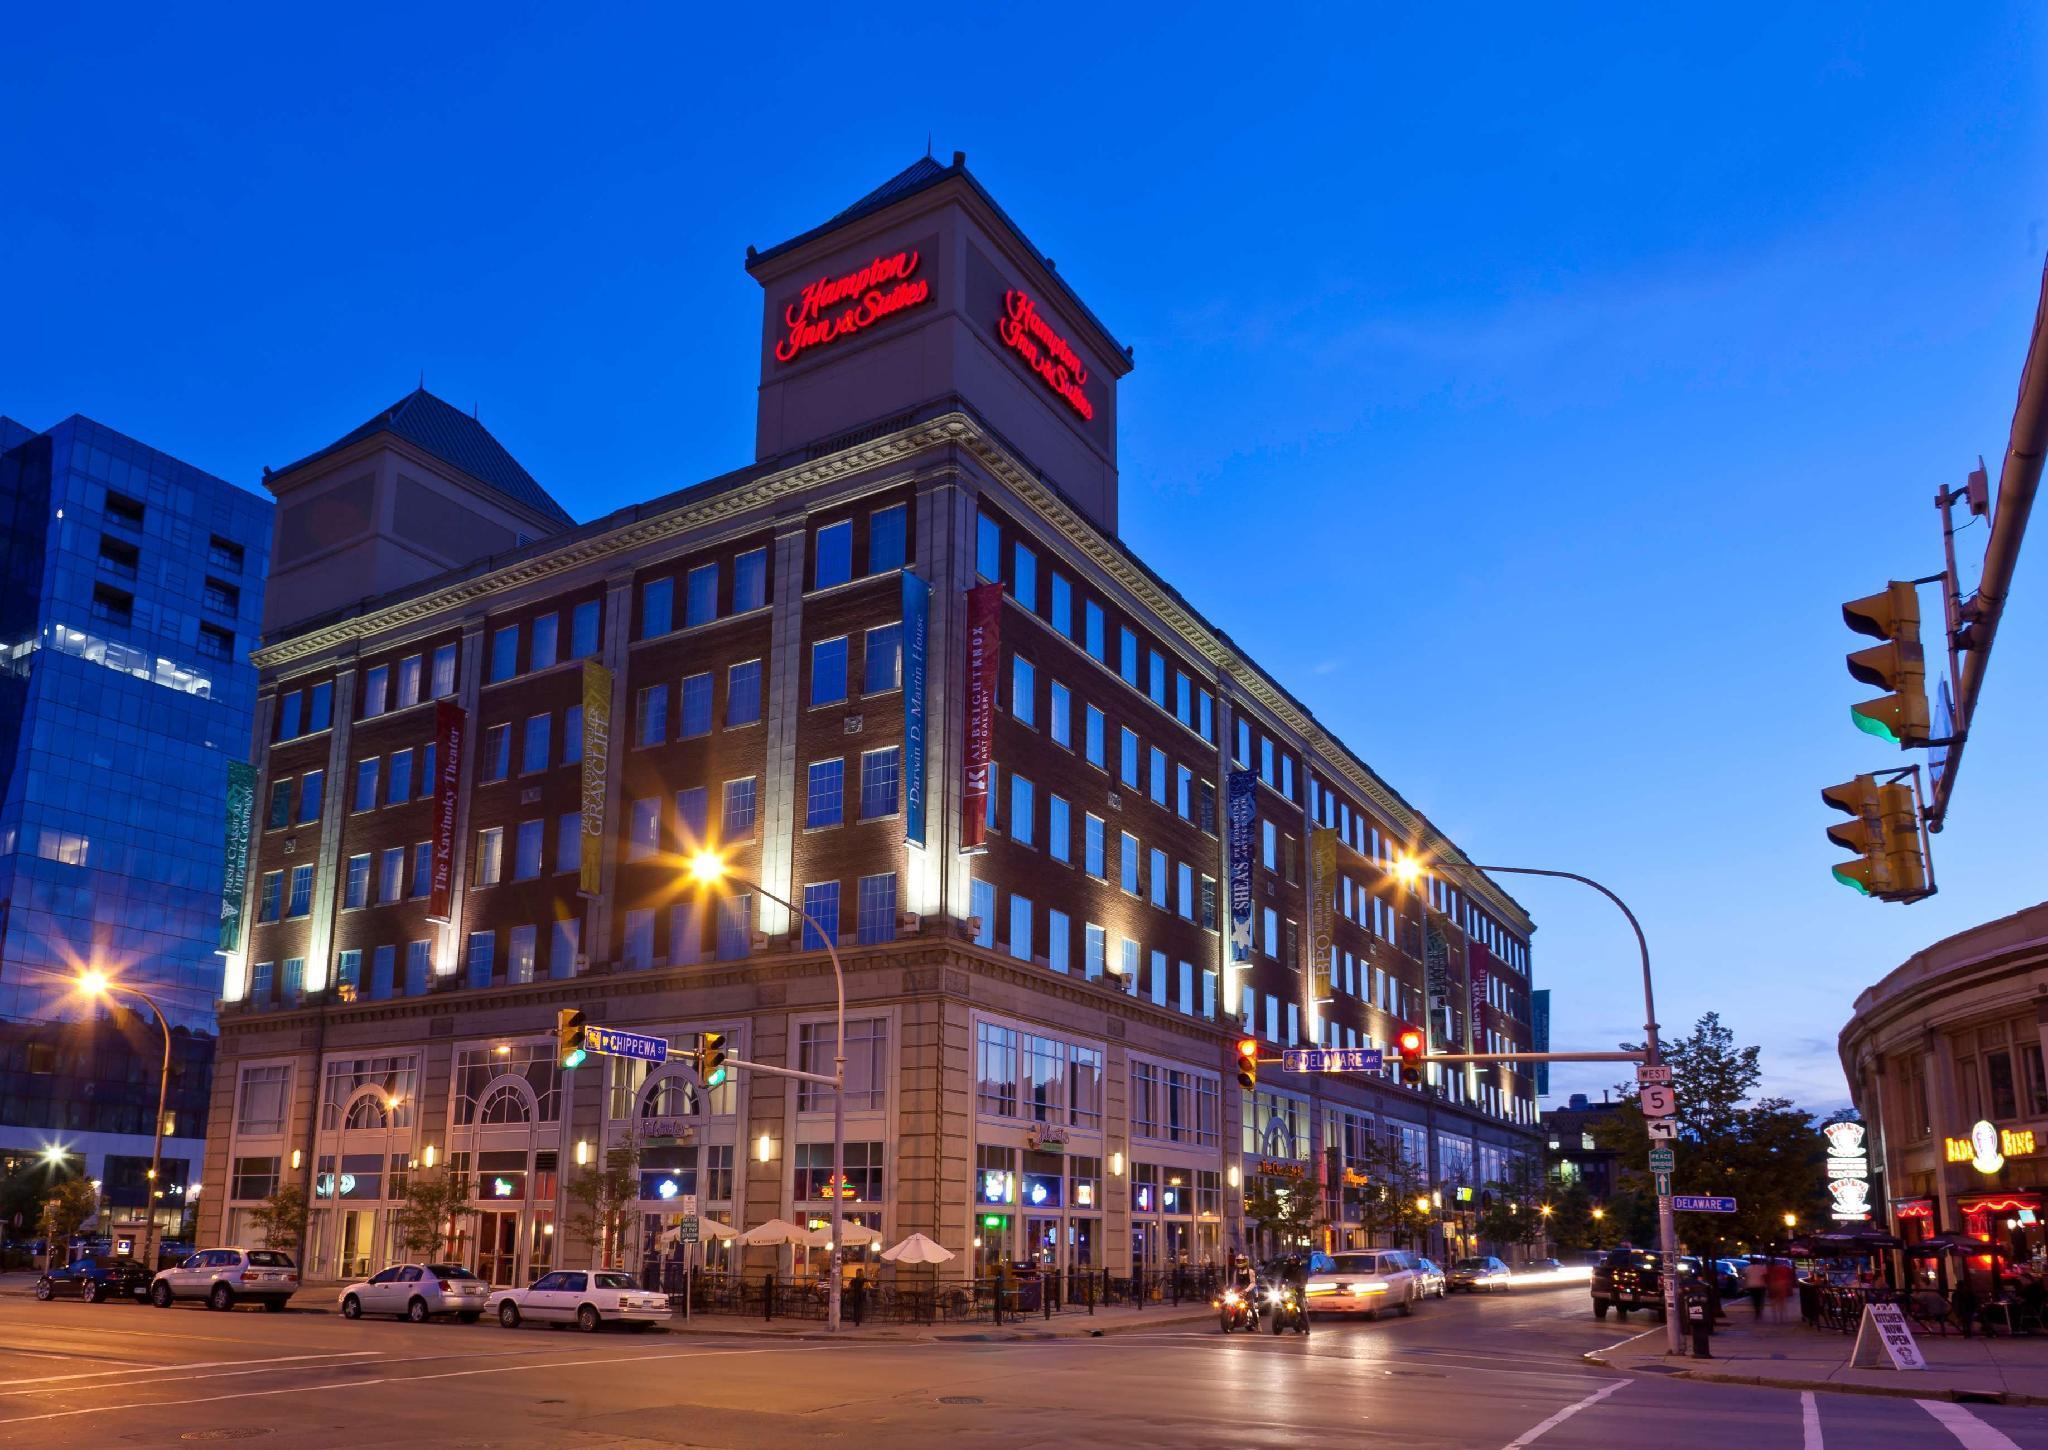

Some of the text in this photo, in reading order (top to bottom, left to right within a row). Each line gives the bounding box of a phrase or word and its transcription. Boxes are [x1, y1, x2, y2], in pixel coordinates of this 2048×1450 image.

[785, 250, 918, 326] Hampton
[776, 318, 837, 362] Inn
[853, 279, 929, 327] Suites
[1005, 289, 1087, 385] Hampton
[999, 316, 1046, 372] Inn
[1053, 370, 1094, 421] Suites
[908, 613, 924, 810] Darwin D. Martin House
[982, 689, 990, 737] GALLERY
[588, 708, 610, 836] GRAYCLIFF
[433, 726, 460, 892] The Kavinoky Theater
[223, 802, 242, 894] IRISH CLASSICAL
[232, 785, 254, 895] THEATER COMPANY
[1234, 861, 1249, 910] SHEA'S
[1315, 935, 1331, 976] BPO
[1471, 979, 1482, 1039] alleyway
[610, 1035, 656, 1057] CHIPPEWA
[657, 1047, 665, 1055] ST
[1300, 1053, 1363, 1067] DELAWARE
[1641, 1069, 1666, 1079] WEST
[1651, 1092, 1664, 1109] 5
[1945, 1129, 2034, 1162] BADA BING
[1676, 1199, 1722, 1210] DELAWARE
[1873, 1313, 1905, 1323] KITCHEN
[1883, 1324, 1904, 1334] NOW
[1887, 1335, 1911, 1345] OPEN
